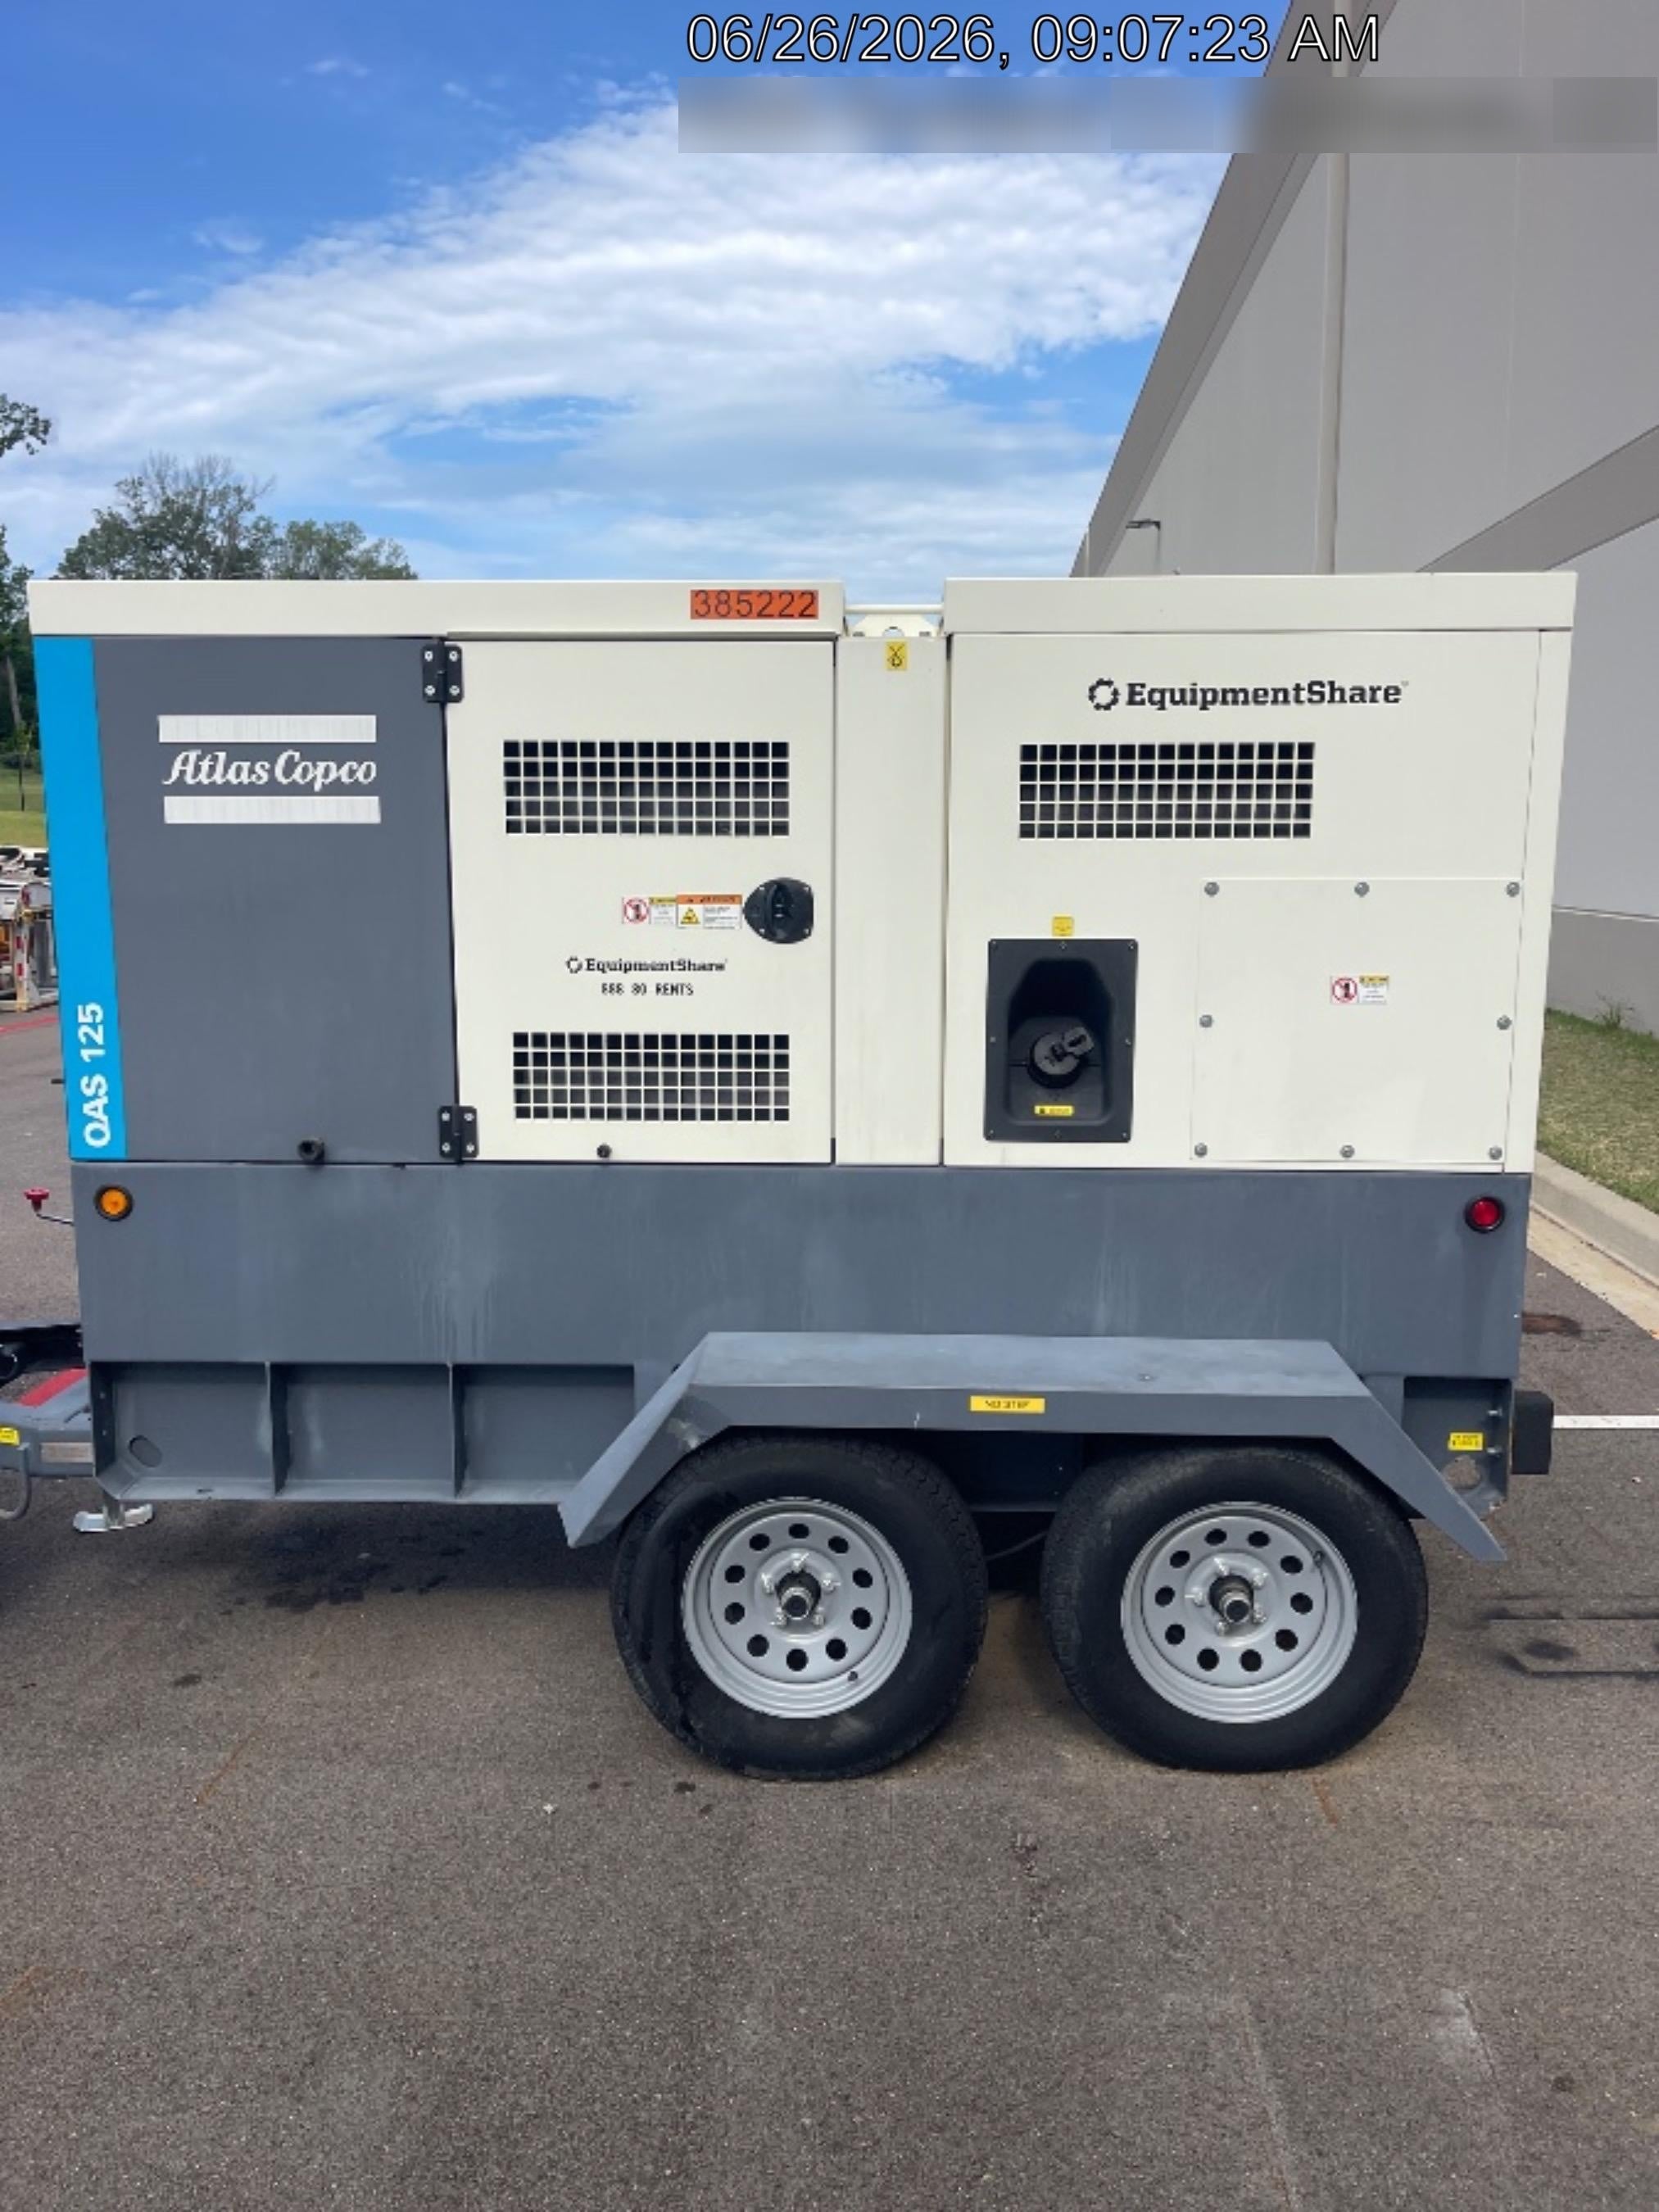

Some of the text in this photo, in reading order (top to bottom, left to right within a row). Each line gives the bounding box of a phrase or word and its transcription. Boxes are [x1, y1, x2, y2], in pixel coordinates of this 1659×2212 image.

[694, 589, 816, 618] 385222
[1126, 681, 1403, 710] EquipmentShare
[162, 749, 378, 792] Atlas Copco
[585, 958, 726, 973] EquipmentShare
[655, 982, 694, 996] RENTS
[77, 1002, 111, 1148] QAS 125
